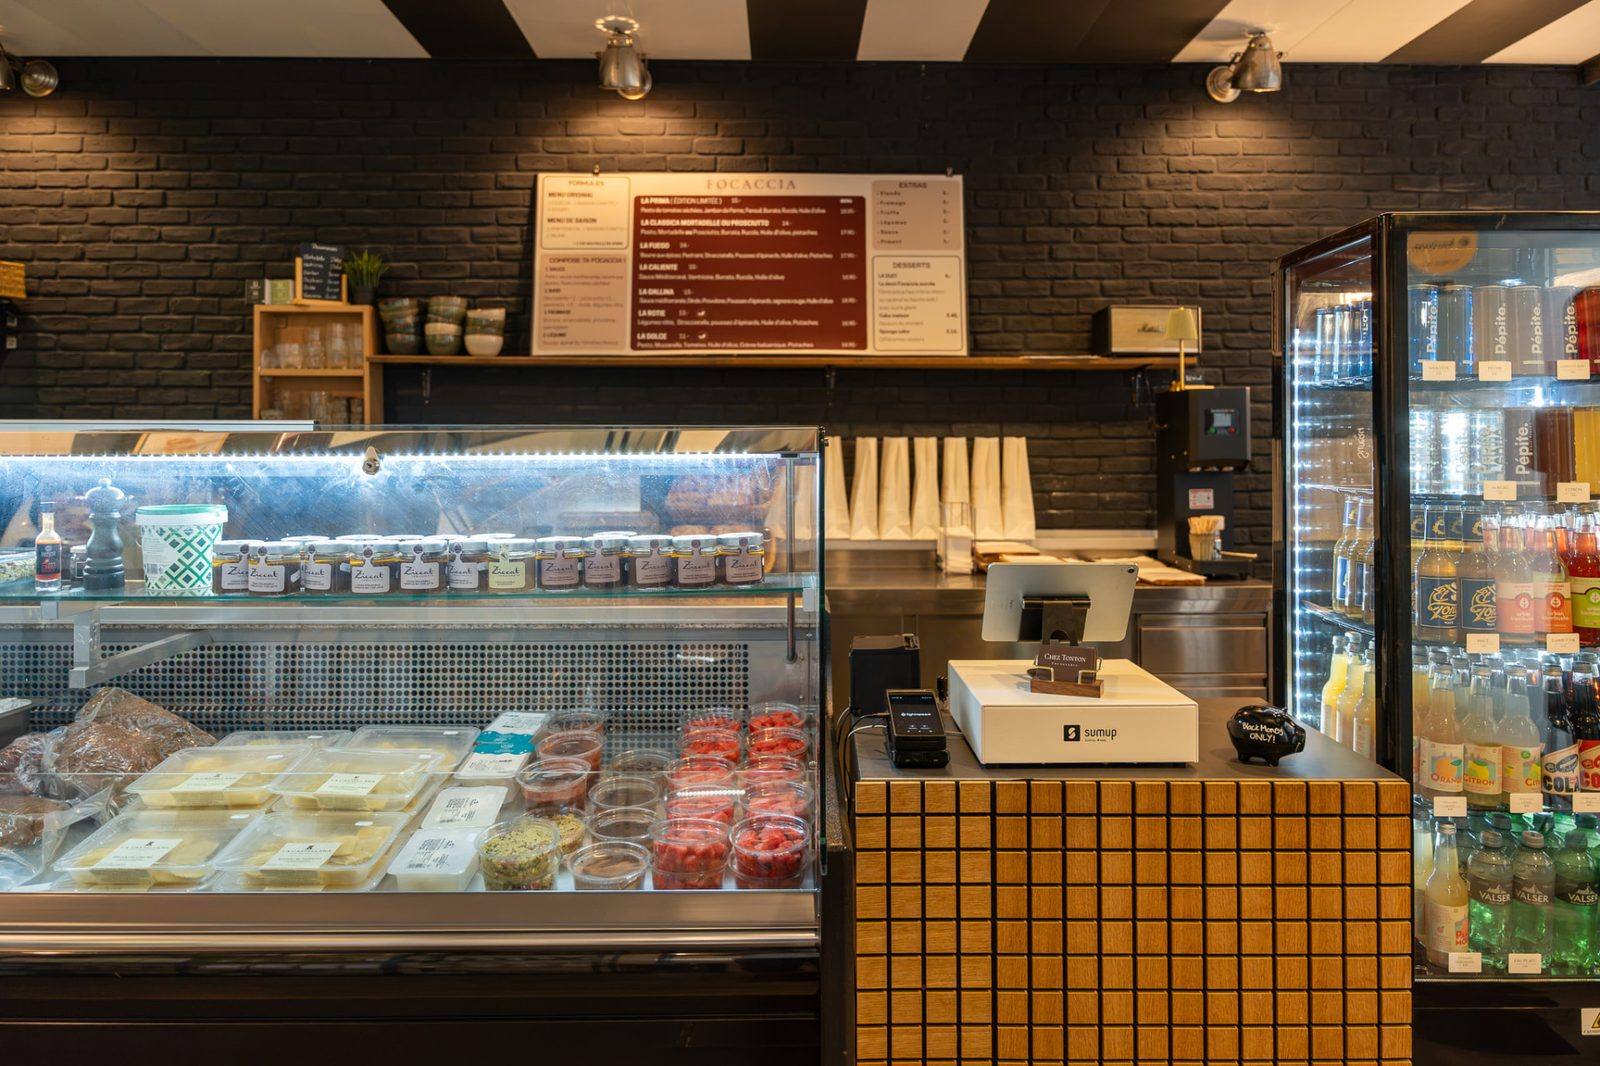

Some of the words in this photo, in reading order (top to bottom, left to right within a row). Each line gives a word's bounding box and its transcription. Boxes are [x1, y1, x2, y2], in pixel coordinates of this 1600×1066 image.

[707, 179, 796, 190] FOCACCIA
[1494, 303, 1508, 354] Pépite.
[1530, 303, 1543, 354] Pépite.
[1564, 302, 1578, 354] Pépite.
[1514, 422, 1533, 474] Pépite.
[354, 569, 384, 580] Ziccat
[404, 565, 434, 576] Ziccat
[491, 566, 520, 575] Ziccat
[1044, 652, 1060, 660] CHEZ
[1062, 654, 1087, 662] TONTON
[1084, 728, 1118, 740] sumup
[1242, 722, 1260, 732] Black
[1260, 724, 1284, 736] Money
[1250, 732, 1276, 744] ONLY!
[1480, 890, 1511, 902] VALSER
[1515, 888, 1549, 903] VALSER
